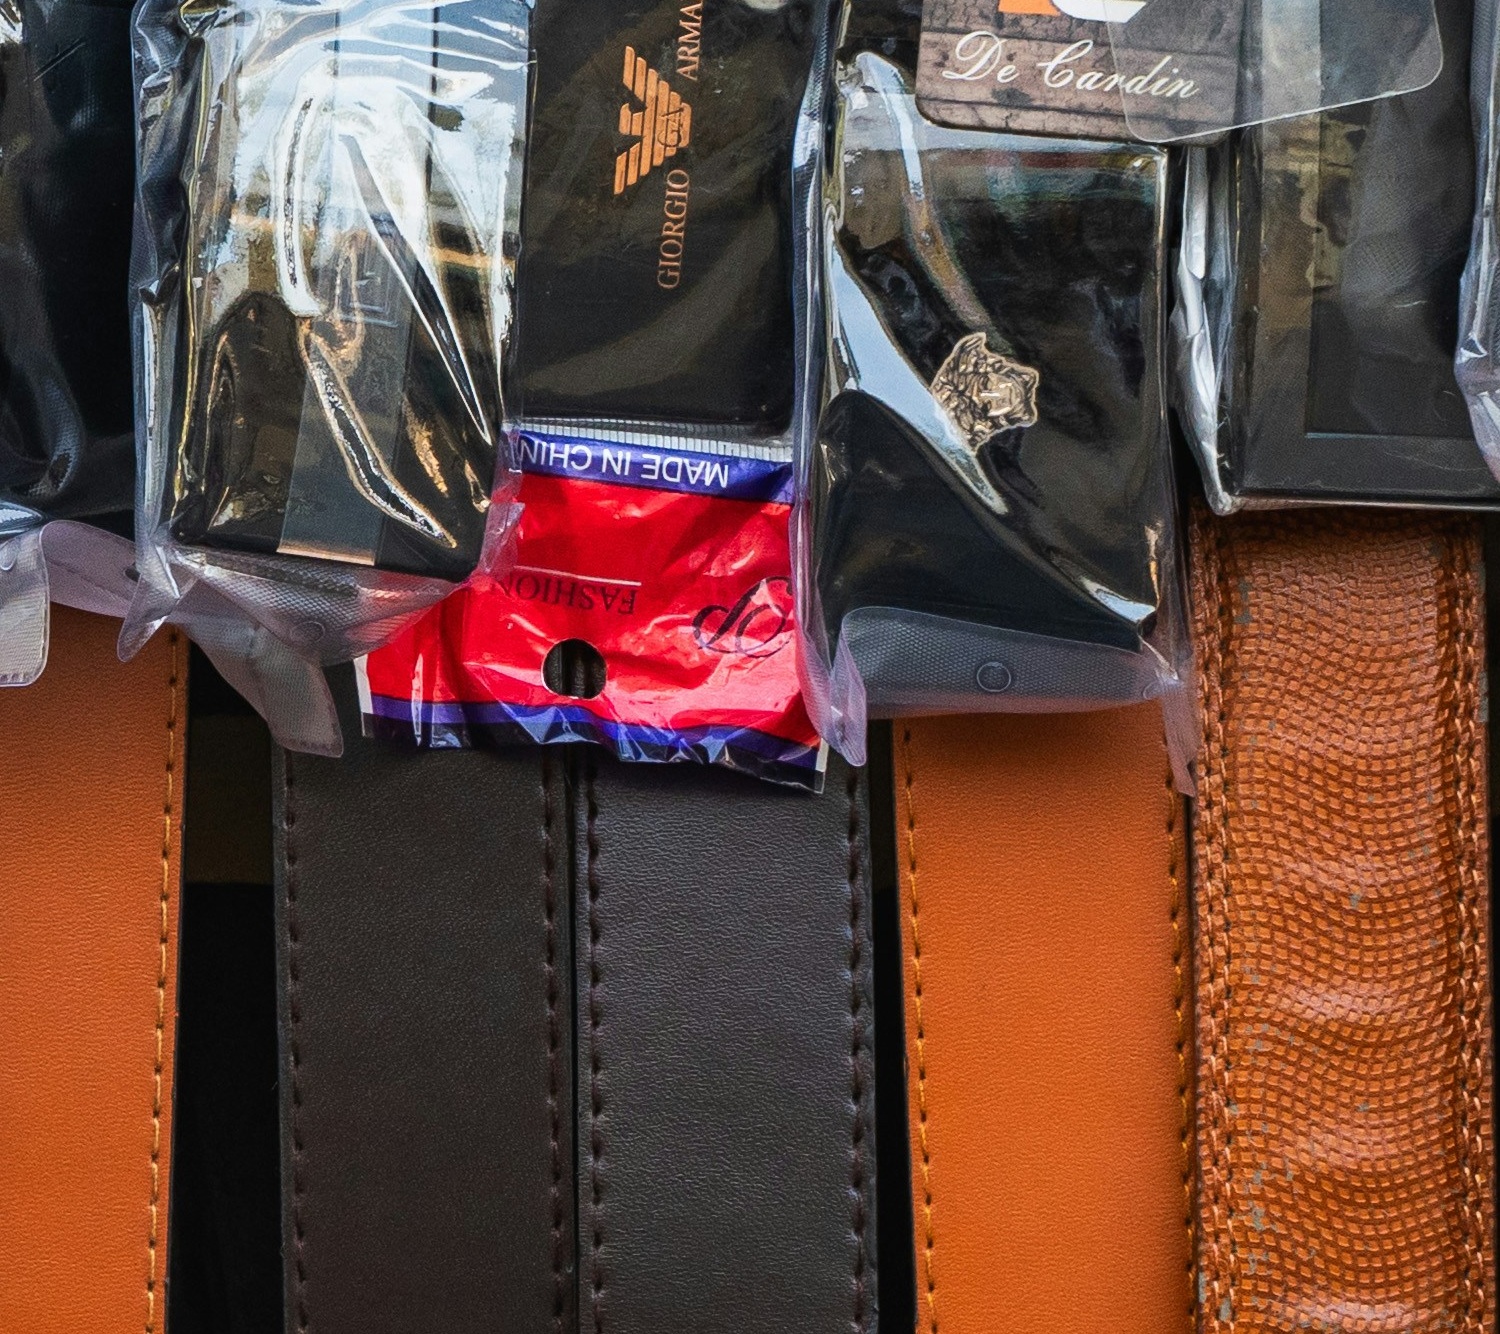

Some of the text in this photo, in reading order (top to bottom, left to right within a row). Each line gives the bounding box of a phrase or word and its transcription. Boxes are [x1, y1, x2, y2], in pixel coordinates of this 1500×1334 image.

[942, 30, 1199, 99] De Cardin
[656, 168, 691, 290] GIORGIO
[602, 449, 631, 476] IN
[640, 453, 729, 488] MADE
